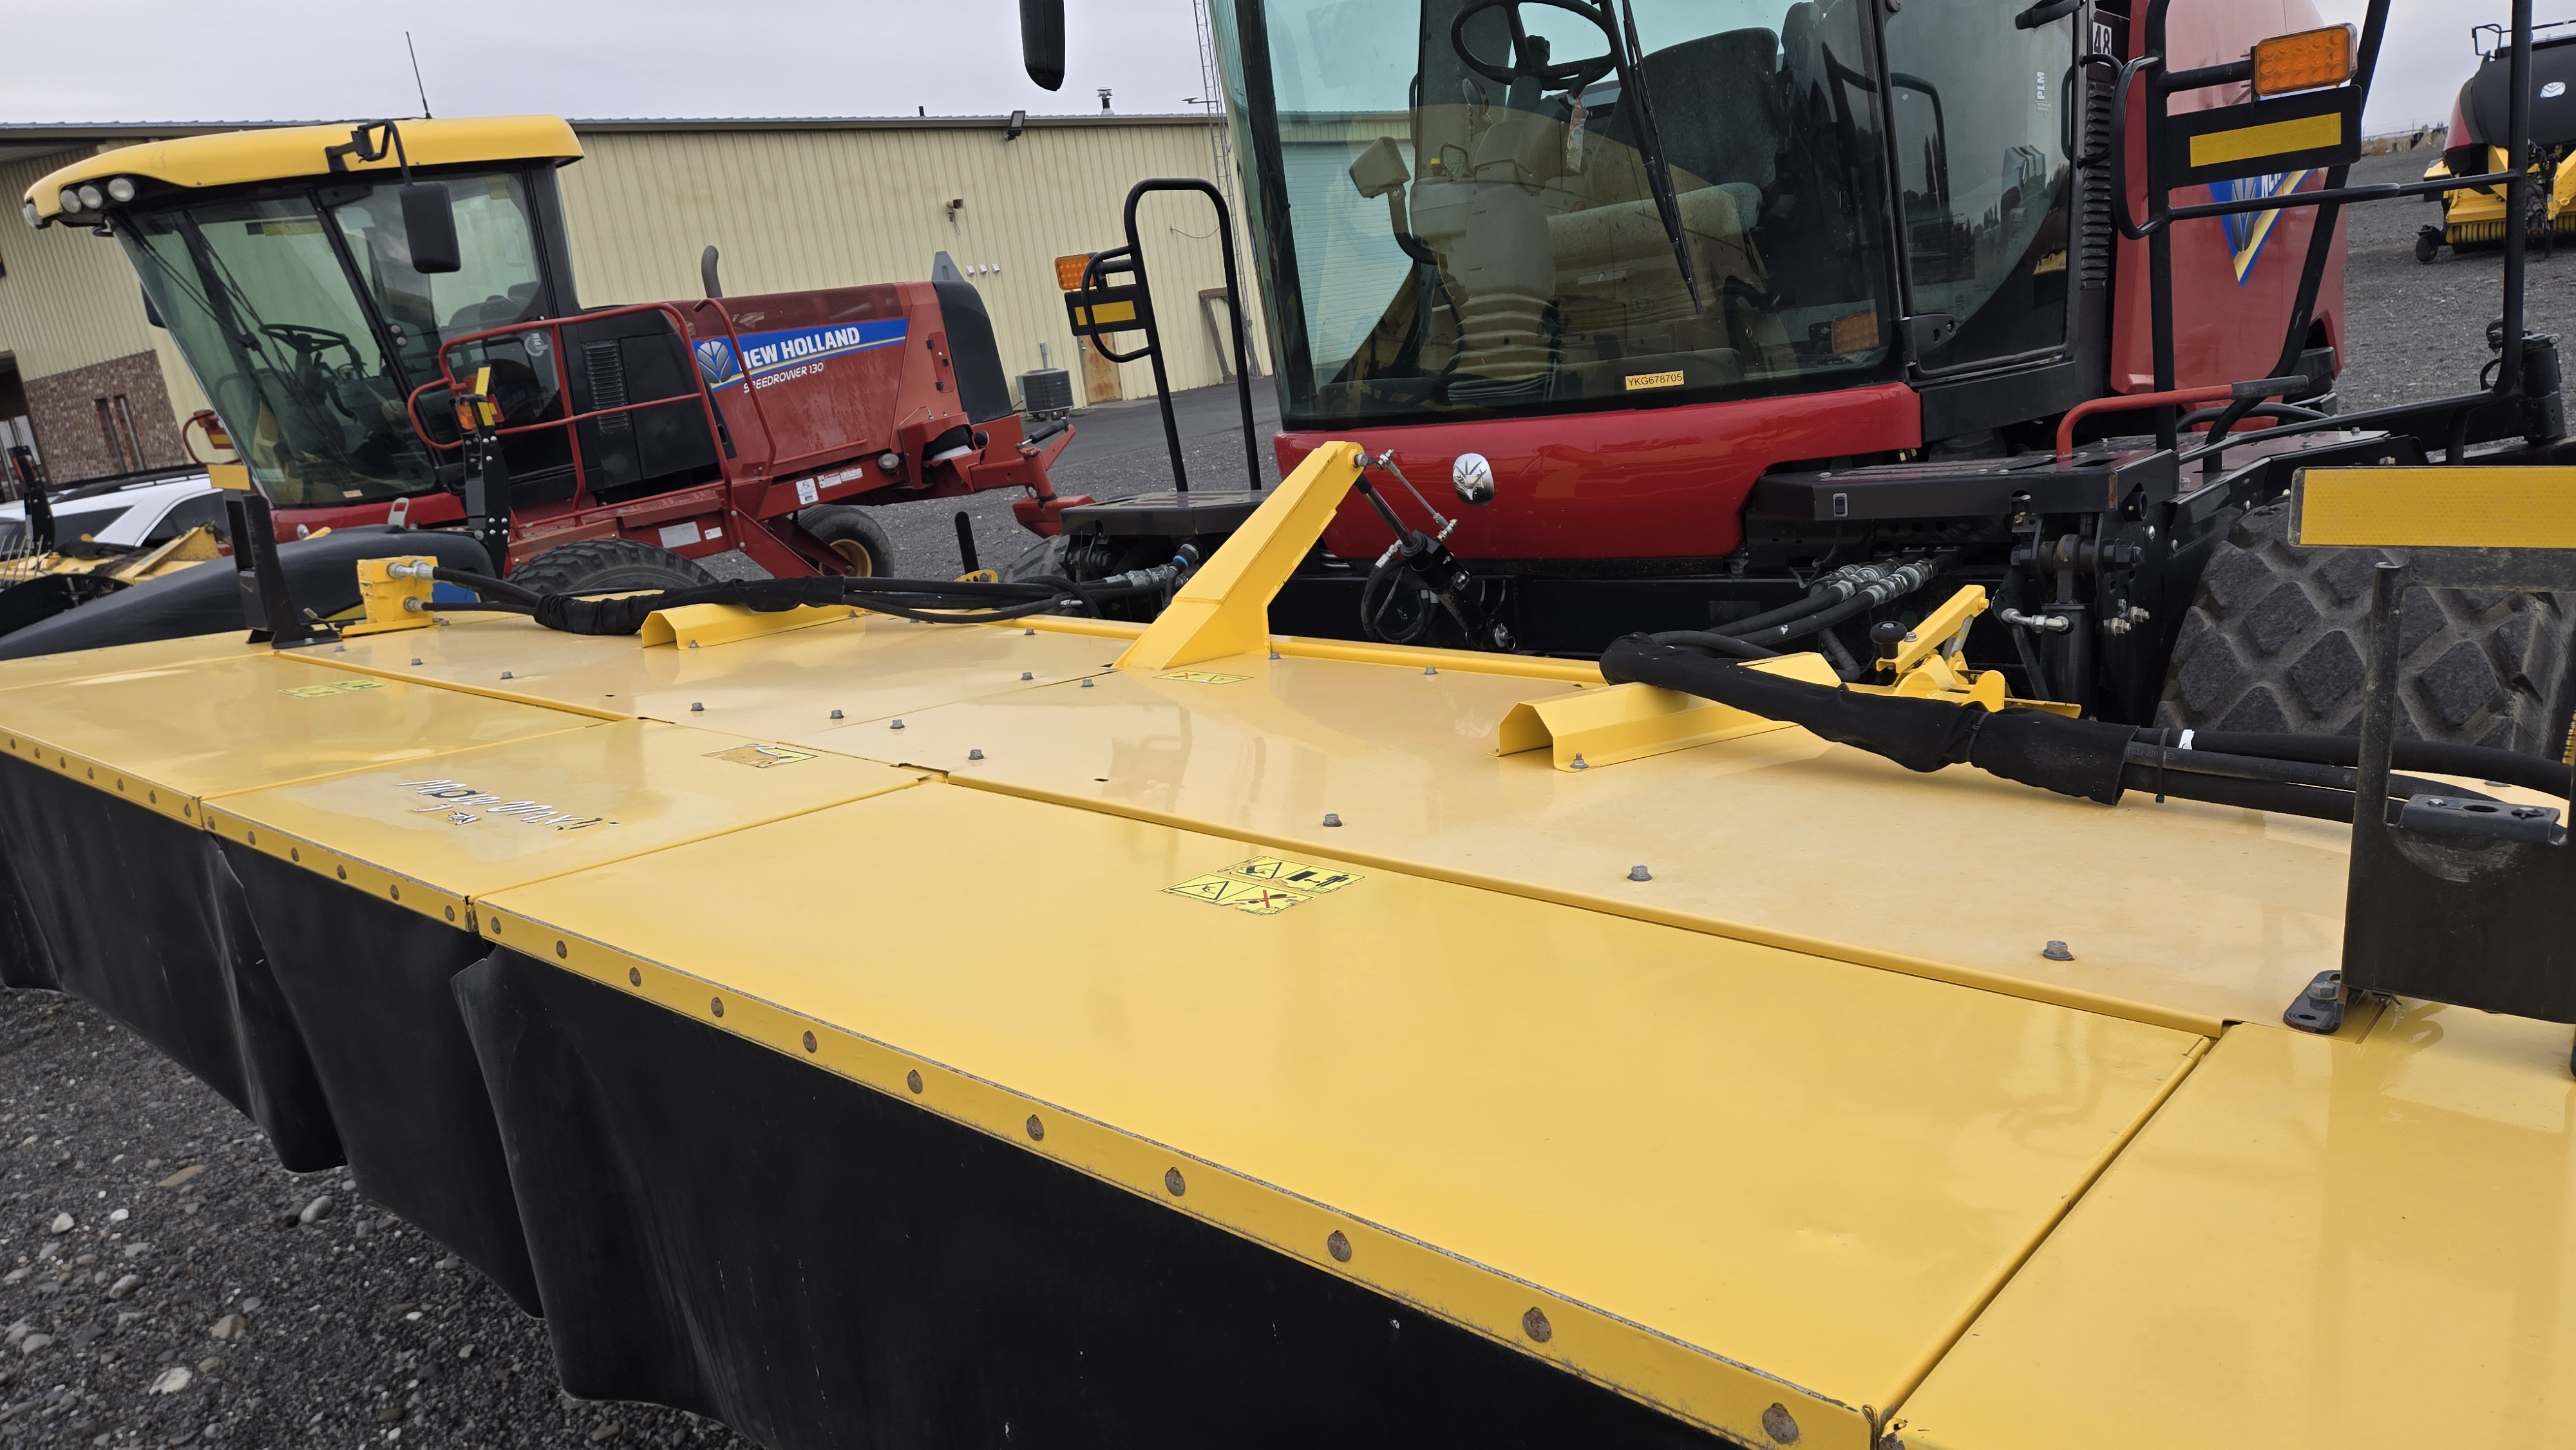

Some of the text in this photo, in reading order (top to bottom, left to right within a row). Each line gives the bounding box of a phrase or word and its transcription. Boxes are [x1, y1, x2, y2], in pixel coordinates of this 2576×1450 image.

[2094, 25, 2110, 55] 48
[2037, 71, 2045, 100] PLM
[780, 326, 860, 359] HOLLAND
[743, 362, 824, 393] SEEDROWER 130
[1627, 373, 1683, 386] YKG678705
